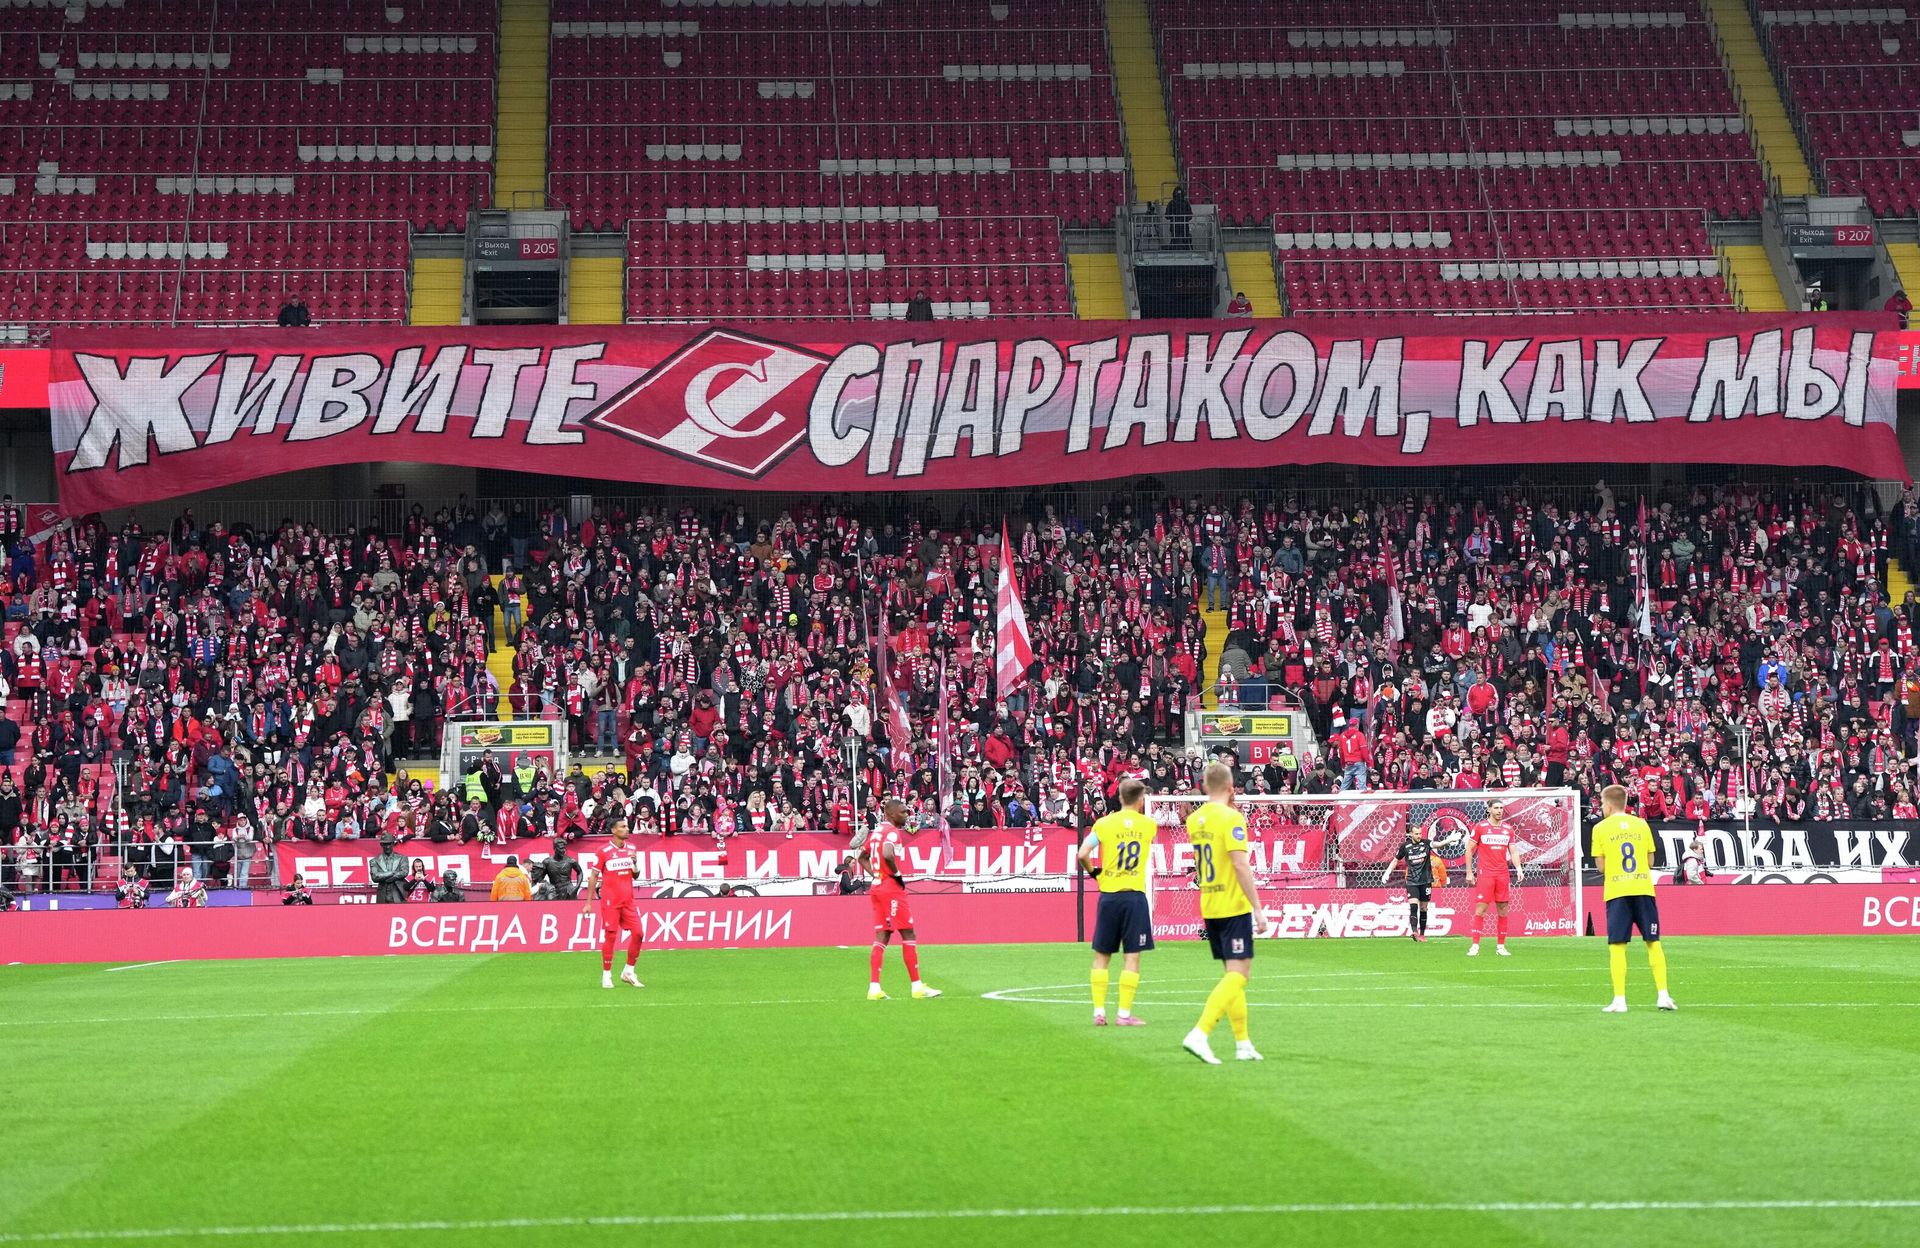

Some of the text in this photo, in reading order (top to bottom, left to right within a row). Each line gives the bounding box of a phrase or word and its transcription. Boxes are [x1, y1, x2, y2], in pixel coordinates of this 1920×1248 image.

[1800, 228, 1825, 236] Выход
[1849, 230, 1871, 241] 207
[484, 241, 510, 249] Выход
[533, 243, 556, 254] 205
[66, 326, 1875, 477] ЖИВИТЕ СПАРТАКОМ, КАК МЫ
[1360, 810, 1402, 852] ФКСМ
[1116, 841, 1140, 871] 18
[1621, 842, 1636, 873] 8
[1658, 830, 1912, 869] ПОКА ИХ
[295, 852, 472, 888] БЕЯ
[746, 851, 777, 879] И
[800, 842, 1047, 880] МУЧИЙ
[409, 890, 425, 901] 43
[970, 886, 1011, 894] Топливо
[388, 909, 792, 952] ВСЕГДА В ДИЖЕНИИ
[1525, 918, 1577, 932] Альфа Бан
